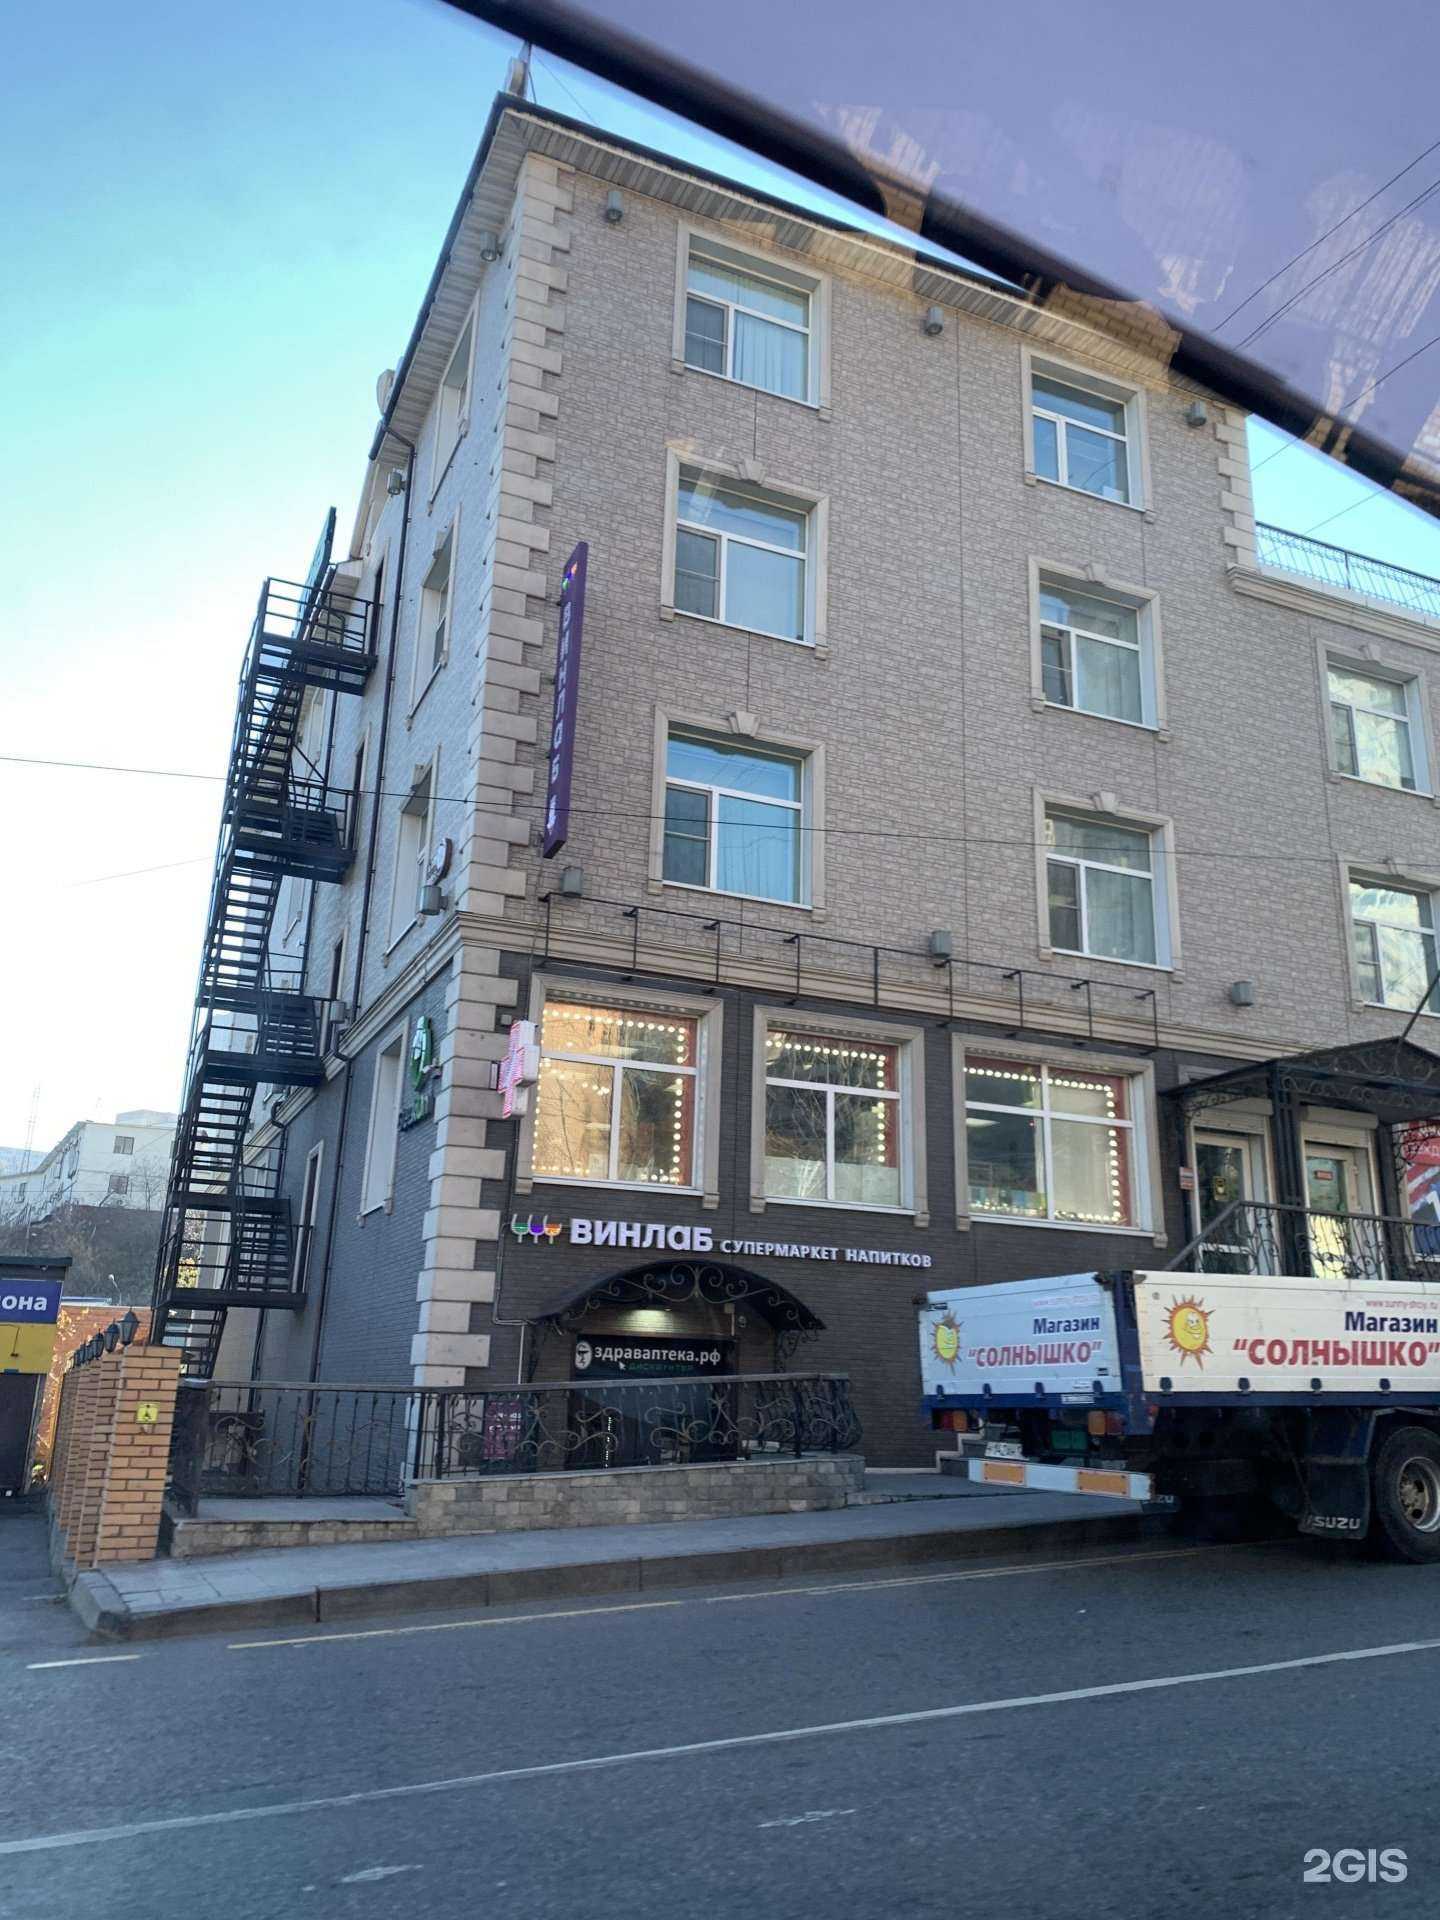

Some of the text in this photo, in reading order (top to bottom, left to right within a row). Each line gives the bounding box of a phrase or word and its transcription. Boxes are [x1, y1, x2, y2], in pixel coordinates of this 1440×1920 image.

[720, 1239, 838, 1260] СУПЕРМАРКЕТ
[845, 1248, 932, 1268] НАПИТКОВ
[0, 1295, 47, 1311] она
[1033, 1317, 1100, 1335] Магазин
[1344, 1311, 1438, 1333] Магазин
[594, 1345, 720, 1366] здраваптека.рф
